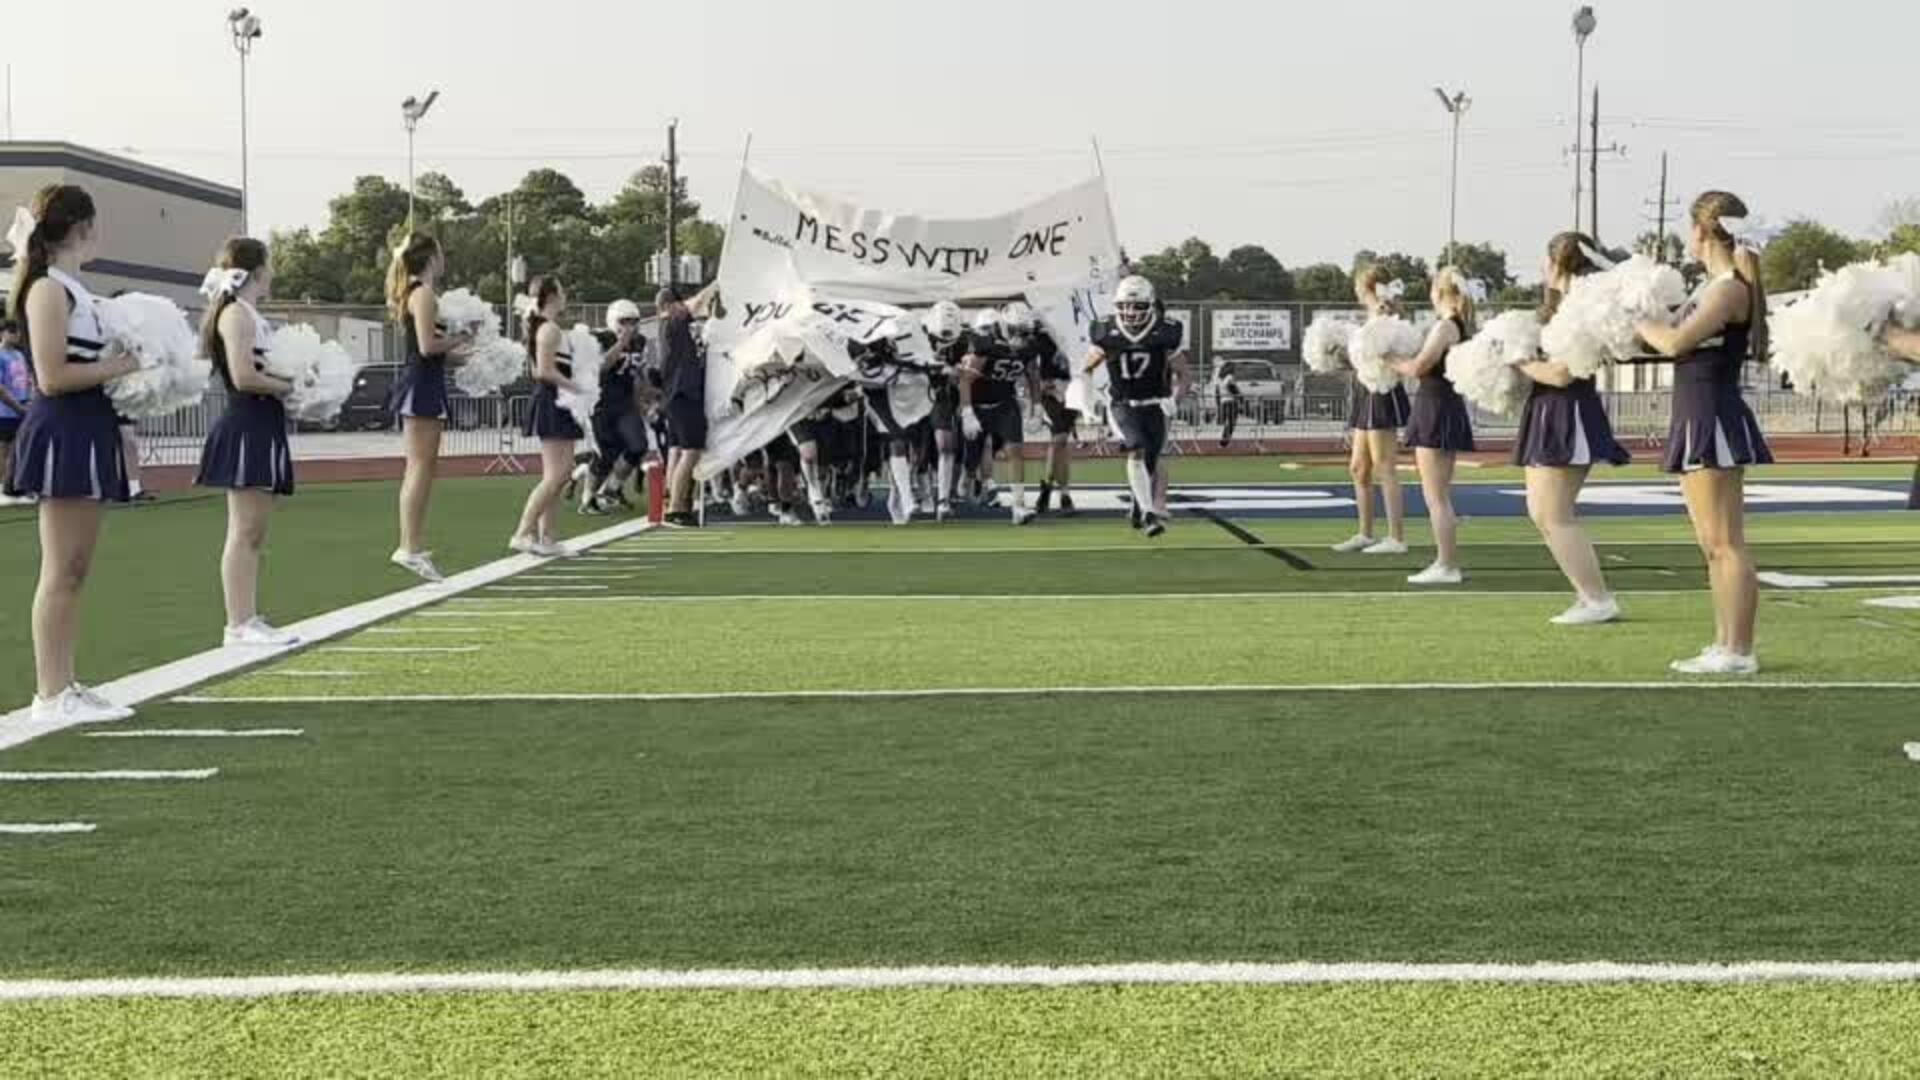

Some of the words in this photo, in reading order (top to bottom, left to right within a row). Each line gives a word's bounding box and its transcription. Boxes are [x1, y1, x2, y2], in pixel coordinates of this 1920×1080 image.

[796, 211, 891, 264] MESS
[897, 242, 989, 277] WITH
[1008, 221, 1069, 258] ONE
[743, 302, 793, 327] YOU
[1219, 327, 1246, 339] STATE
[1247, 327, 1284, 339] CHAMPS
[991, 359, 1025, 380] 52
[1119, 352, 1151, 379] 17
